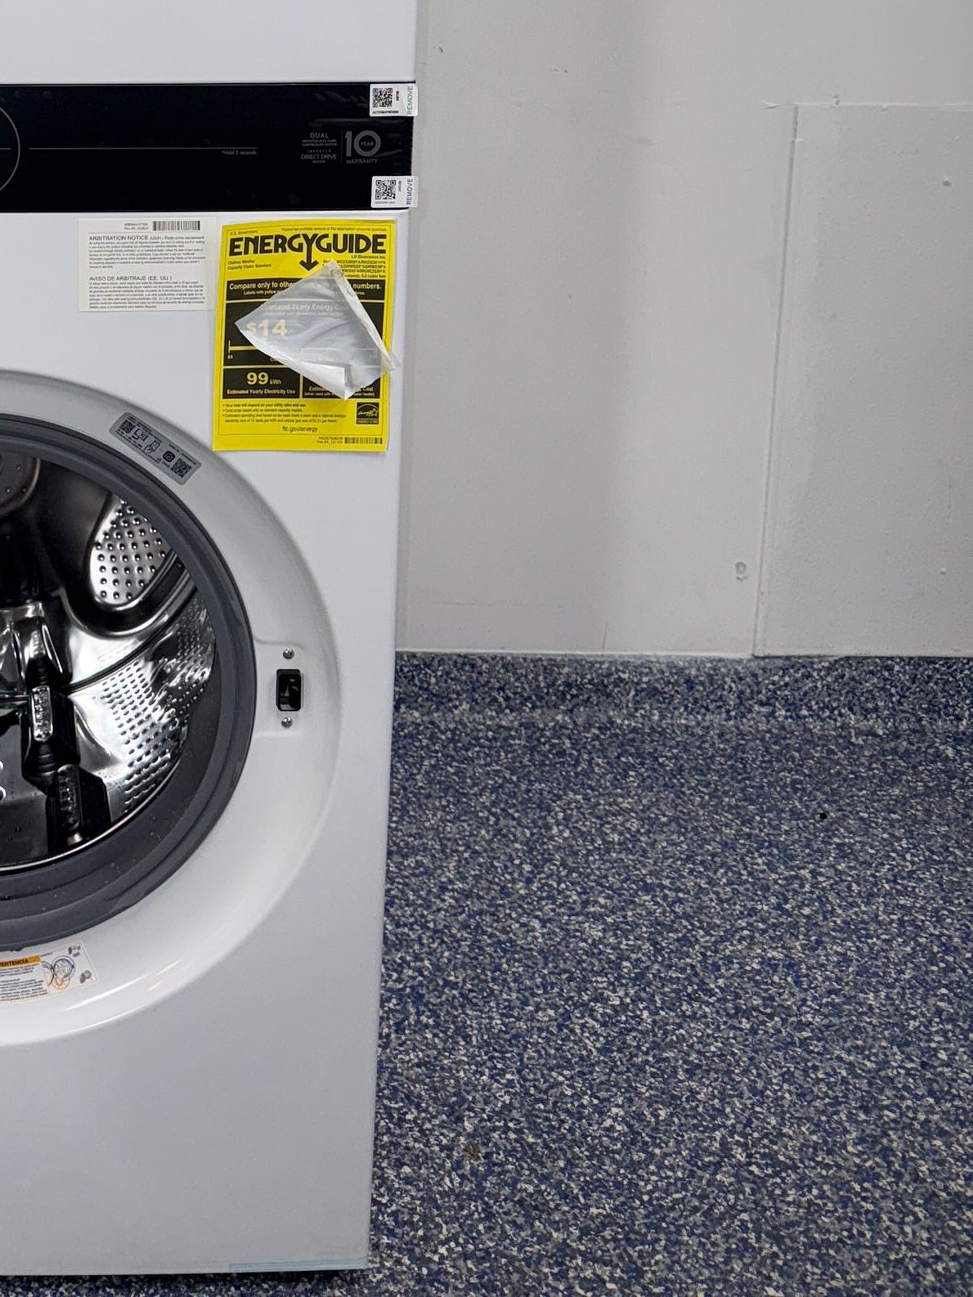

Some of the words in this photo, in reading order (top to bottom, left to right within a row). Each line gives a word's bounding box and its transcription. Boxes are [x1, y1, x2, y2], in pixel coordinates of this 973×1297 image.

[406, 86, 414, 115] REMOVE
[344, 129, 382, 158] 10
[405, 178, 414, 206] REMOVE
[228, 233, 387, 258] ENERGYGUIDE
[229, 282, 257, 291] Compare
[257, 282, 271, 291] only
[353, 282, 381, 290] numbers.
[312, 304, 333, 312] Energy
[246, 318, 288, 339] $14
[247, 372, 269, 386] 99
[282, 426, 318, 434] ftc.gov/energy
